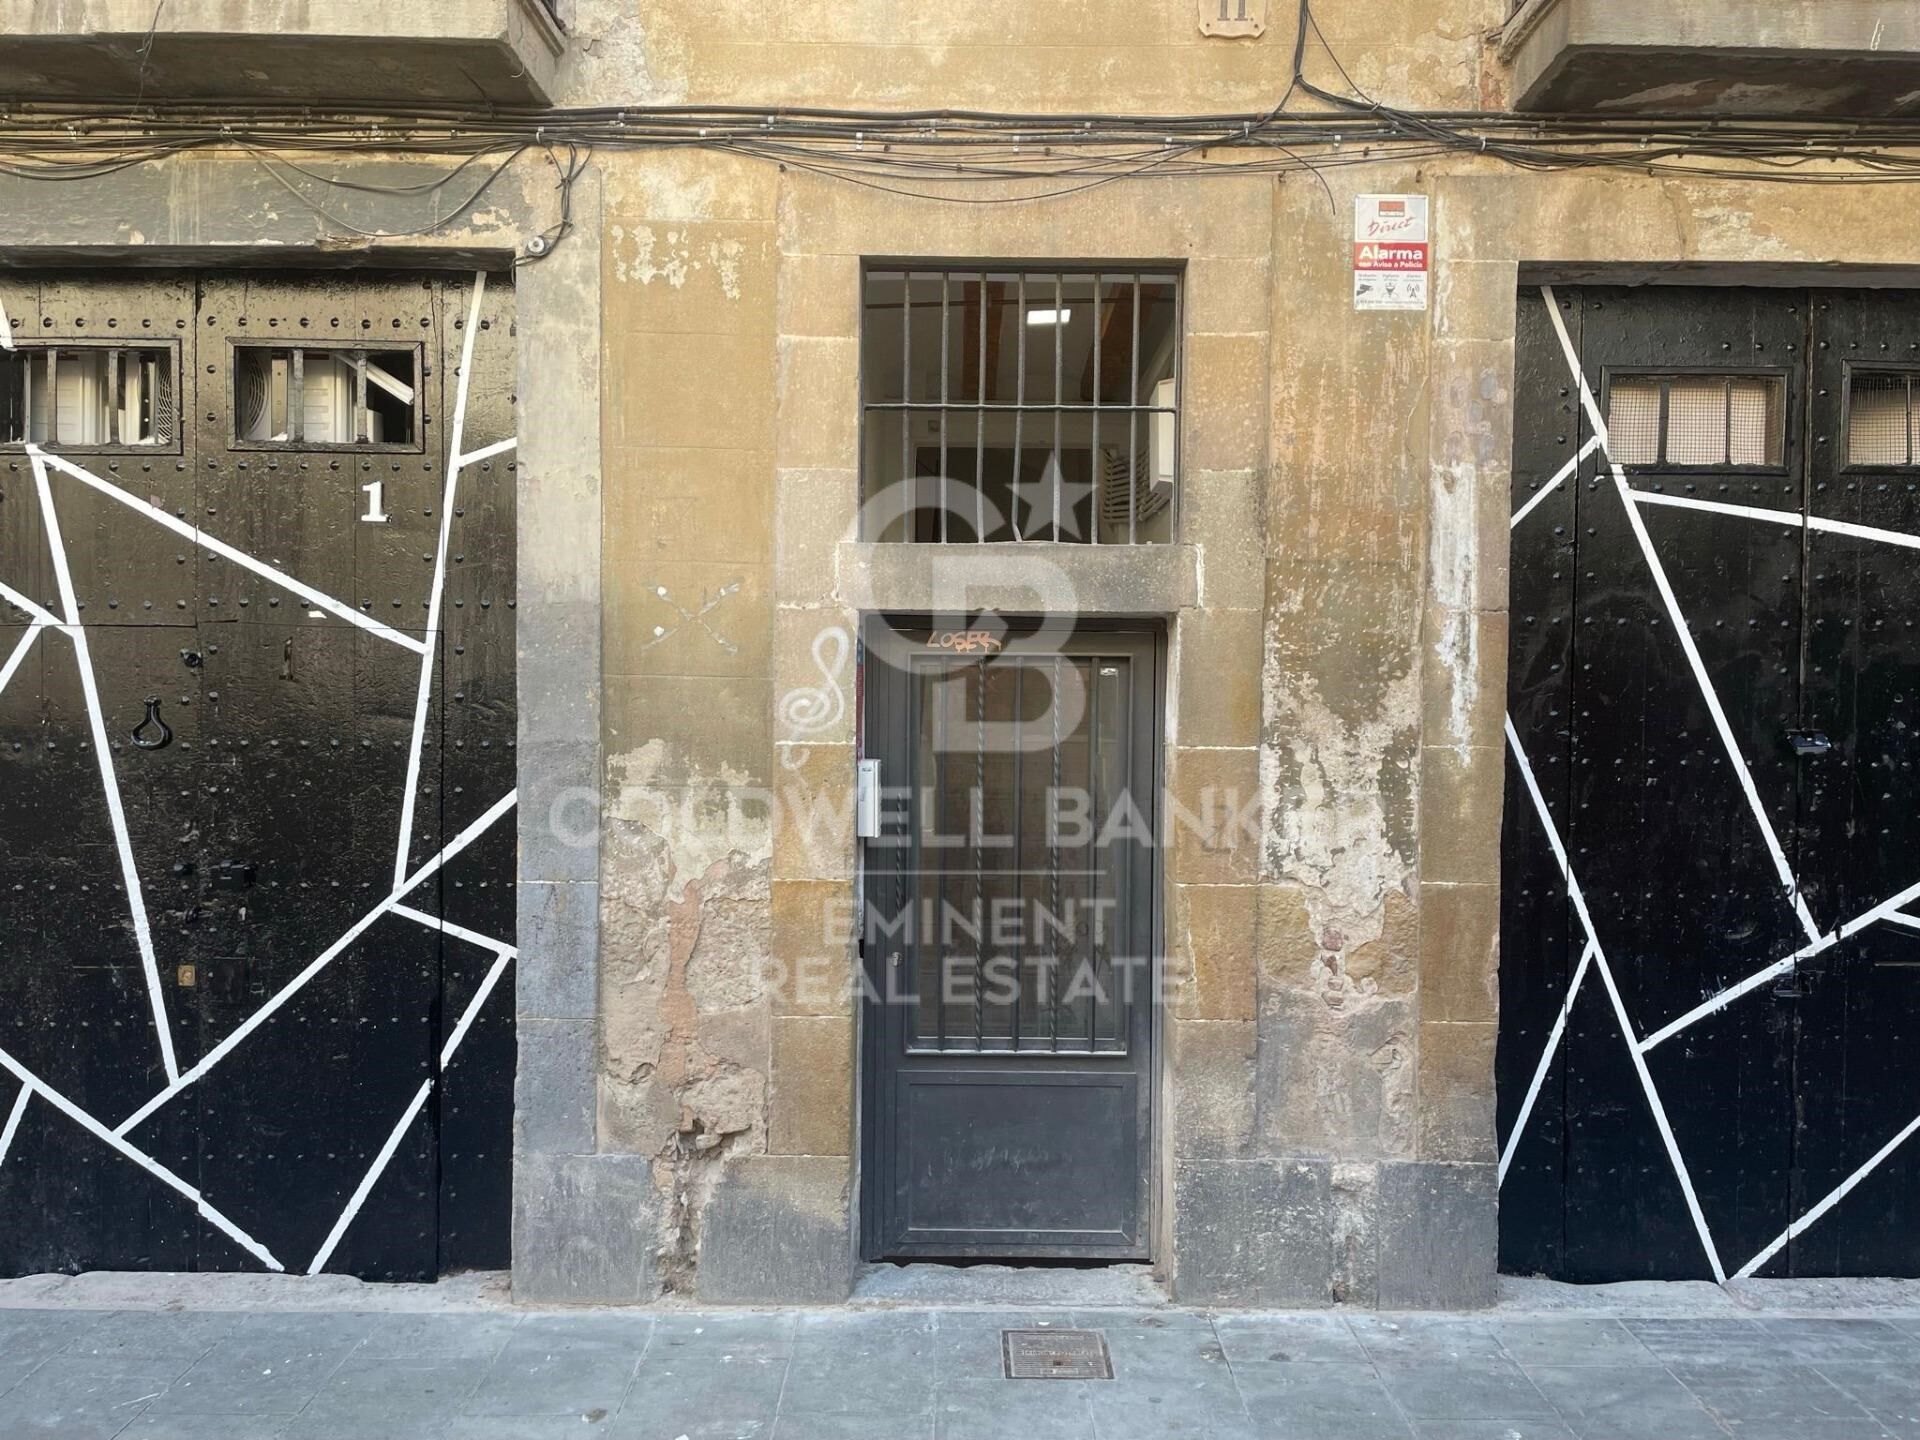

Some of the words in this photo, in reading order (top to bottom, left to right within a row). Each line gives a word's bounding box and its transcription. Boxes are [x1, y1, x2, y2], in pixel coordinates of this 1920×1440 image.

[1368, 216, 1415, 237] Direct
[1359, 245, 1423, 260] Alarma
[361, 481, 387, 522] 1
